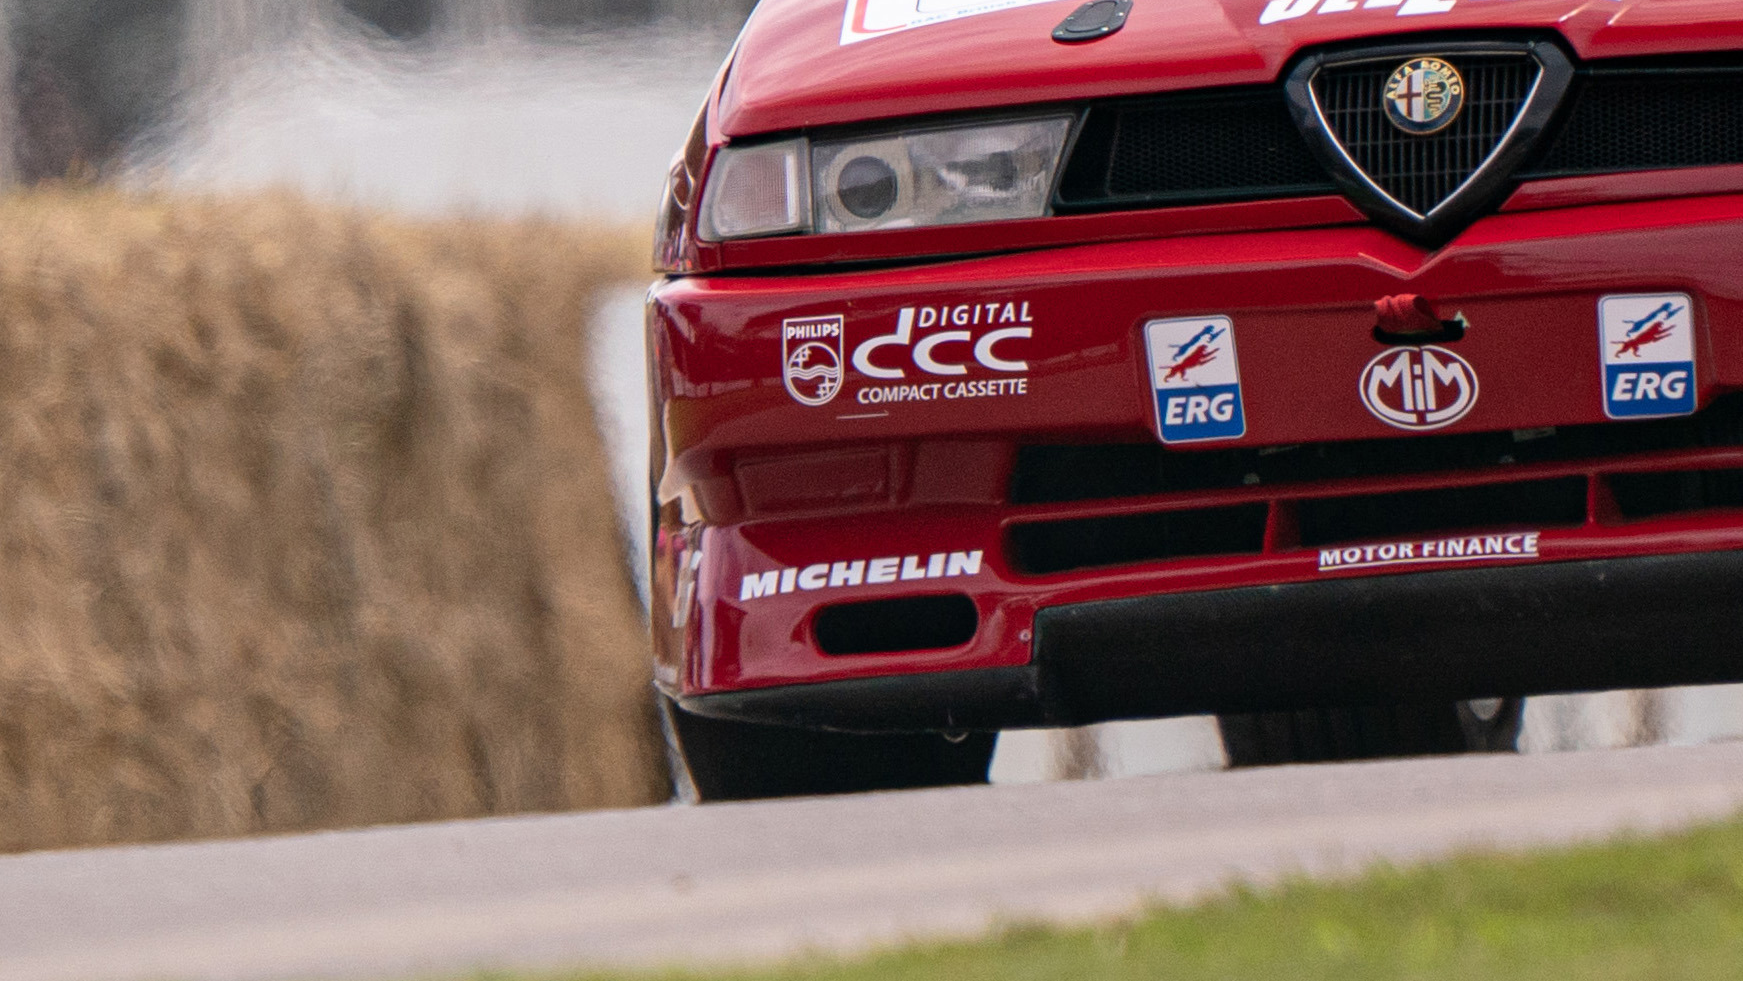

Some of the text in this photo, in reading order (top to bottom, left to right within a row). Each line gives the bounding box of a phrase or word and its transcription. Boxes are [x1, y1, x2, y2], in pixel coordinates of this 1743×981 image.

[1421, 60, 1461, 95] ROMEO
[787, 323, 840, 340] PHILIPS
[918, 302, 1034, 328] DIGITAL
[857, 377, 1028, 406] COMPACT CASSETTE
[1611, 370, 1687, 402] ERG
[1165, 393, 1235, 427] ERG
[1319, 533, 1540, 567] MOTOR FINANCE
[740, 550, 984, 602] MICHELIN
